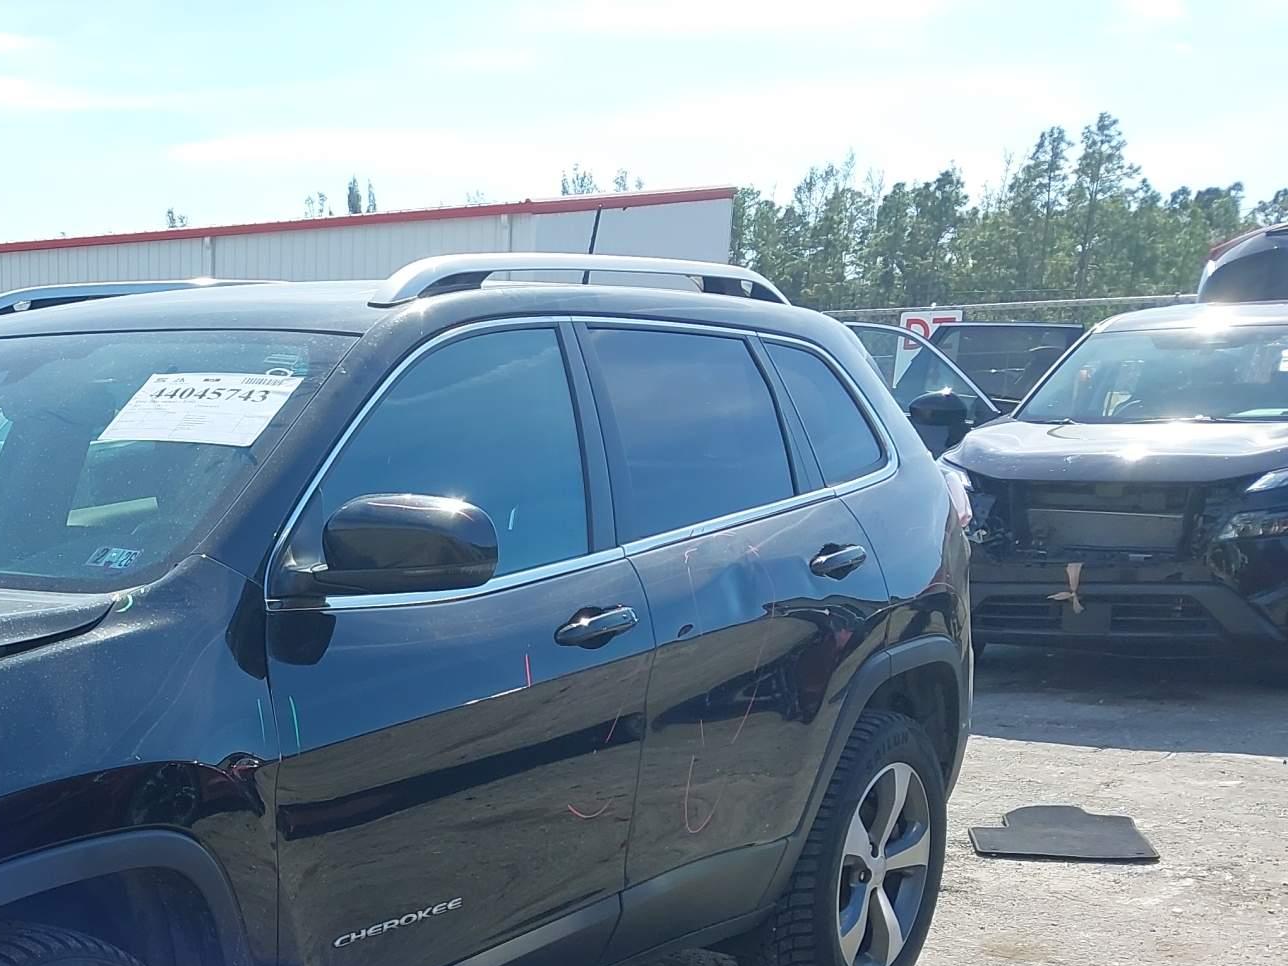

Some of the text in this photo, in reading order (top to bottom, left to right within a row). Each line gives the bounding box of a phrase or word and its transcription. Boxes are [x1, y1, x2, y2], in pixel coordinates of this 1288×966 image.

[903, 317, 957, 350] D
[149, 386, 271, 404] 44045743
[334, 897, 462, 948] CHEROKEE
